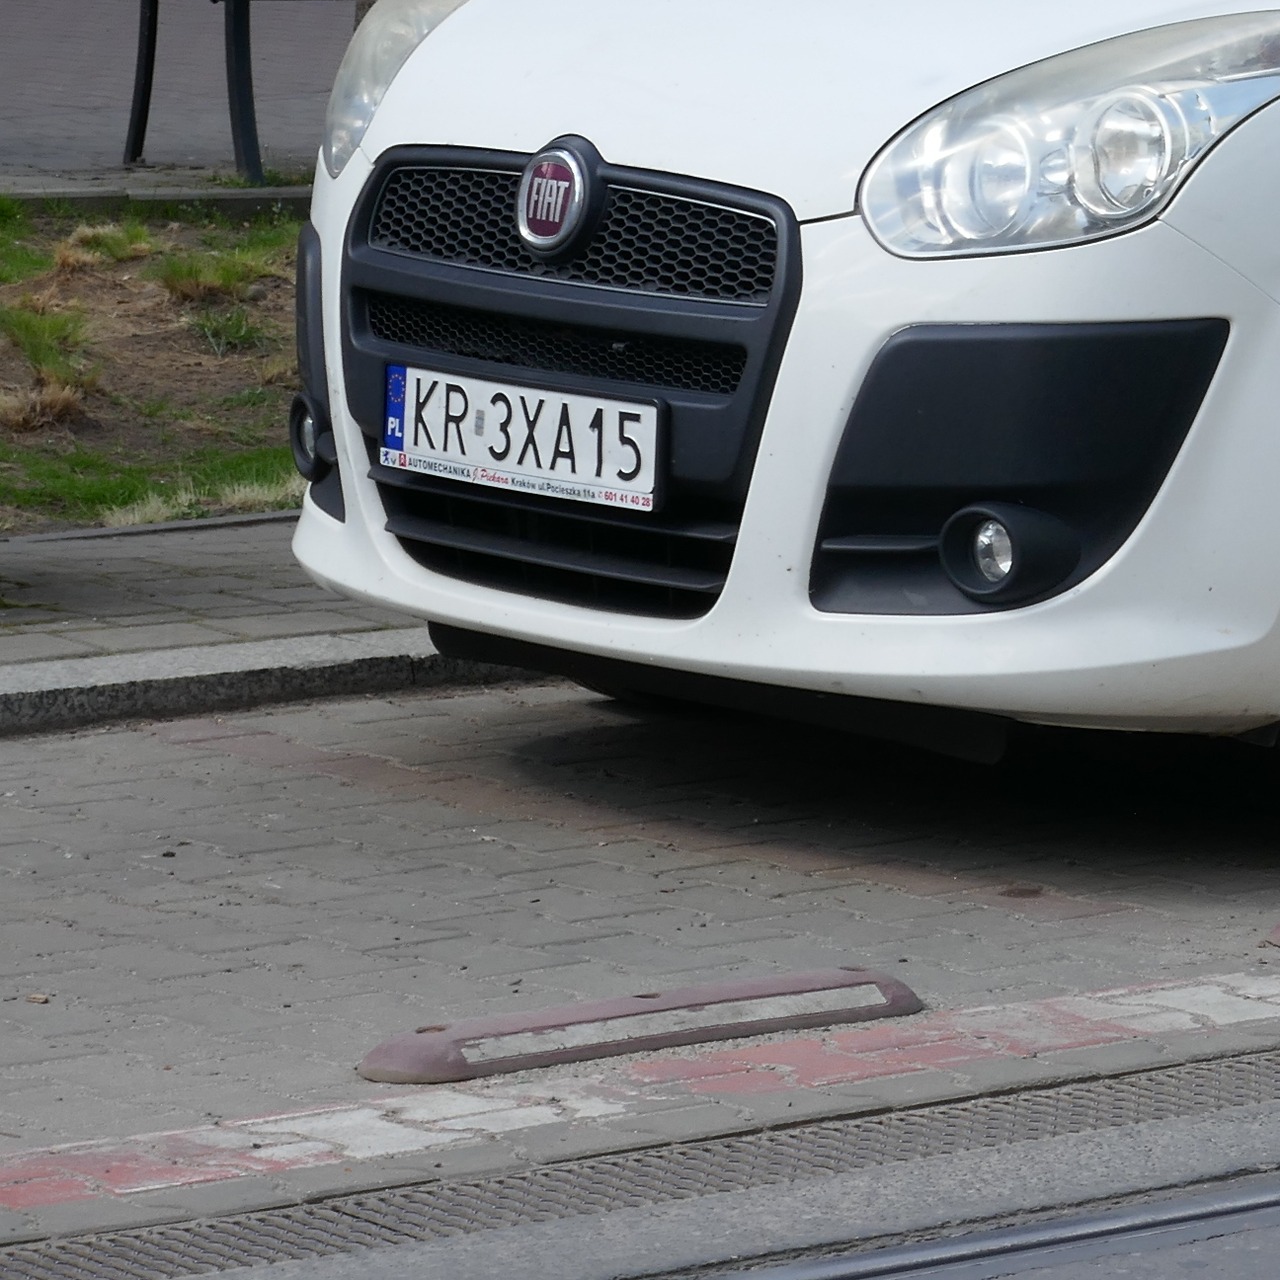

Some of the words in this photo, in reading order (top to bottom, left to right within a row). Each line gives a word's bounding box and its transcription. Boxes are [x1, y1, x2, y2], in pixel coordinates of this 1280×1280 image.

[528, 177, 570, 223] FIAT
[387, 416, 402, 438] PL
[413, 377, 470, 456] KR
[488, 391, 643, 483] 3XA15
[408, 457, 471, 479] AUTOMECHANIKA
